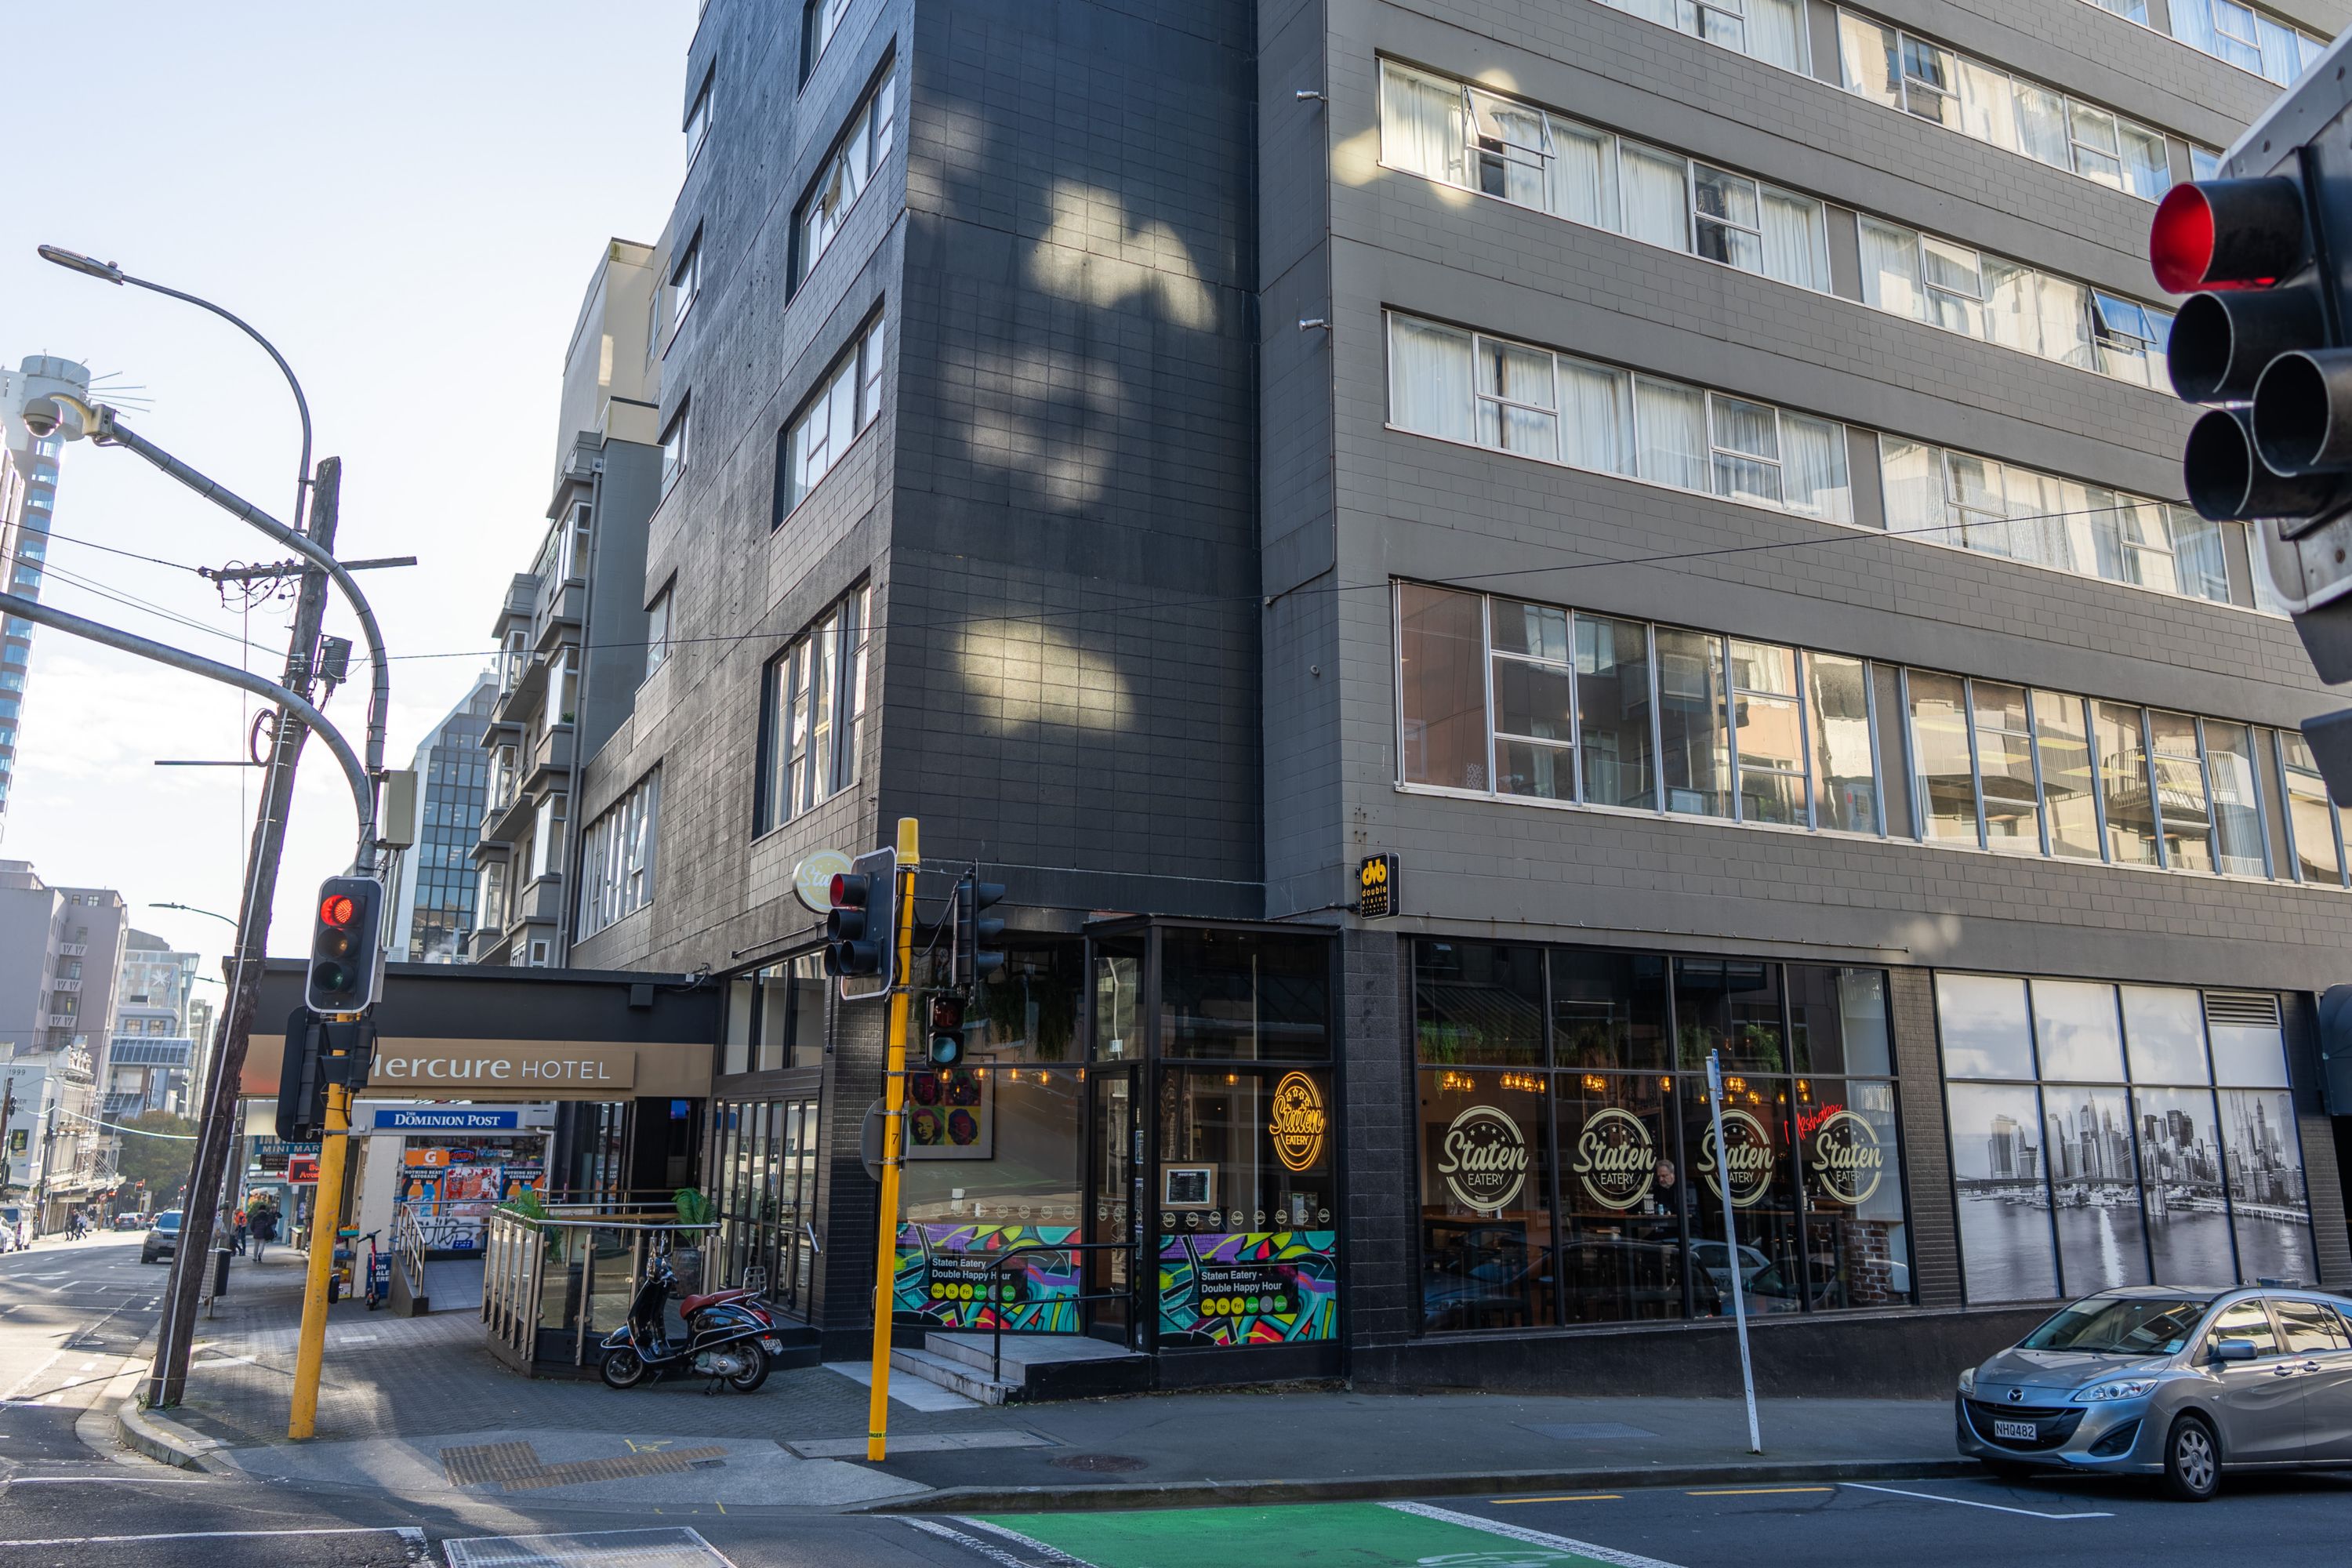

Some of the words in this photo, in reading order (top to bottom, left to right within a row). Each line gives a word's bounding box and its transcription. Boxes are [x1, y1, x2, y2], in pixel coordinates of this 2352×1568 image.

[1363, 886, 1386, 897] double
[1363, 896, 1386, 905] vision
[522, 1060, 610, 1079] HOTEL
[394, 1113, 464, 1126] DOMINION
[467, 1115, 500, 1126] POST
[1269, 1095, 1326, 1134] Staten
[892, 1134, 898, 1145] 7
[1286, 1135, 1308, 1145] EATERY
[1438, 1131, 1529, 1173] Staten
[1573, 1132, 1657, 1173] Staten
[1697, 1132, 1774, 1171] Saten
[1813, 1132, 1883, 1171] Staten
[1468, 1174, 1504, 1185] EATERY
[1601, 1174, 1634, 1185] EATERY
[1730, 1172, 1754, 1183] ATERY
[1837, 1171, 1865, 1182] EATERY
[932, 1258, 957, 1267] Staten
[960, 1259, 986, 1269] Eatery
[932, 1269, 960, 1278] Double
[963, 1270, 989, 1281] Happy
[1201, 1272, 1228, 1280] Staten
[1231, 1271, 1257, 1280] Eatery
[1202, 1284, 1231, 1293] Double
[1233, 1283, 1260, 1293] Happy
[1262, 1282, 1282, 1290] Hour
[1996, 1424, 2034, 1438] NHQ482
